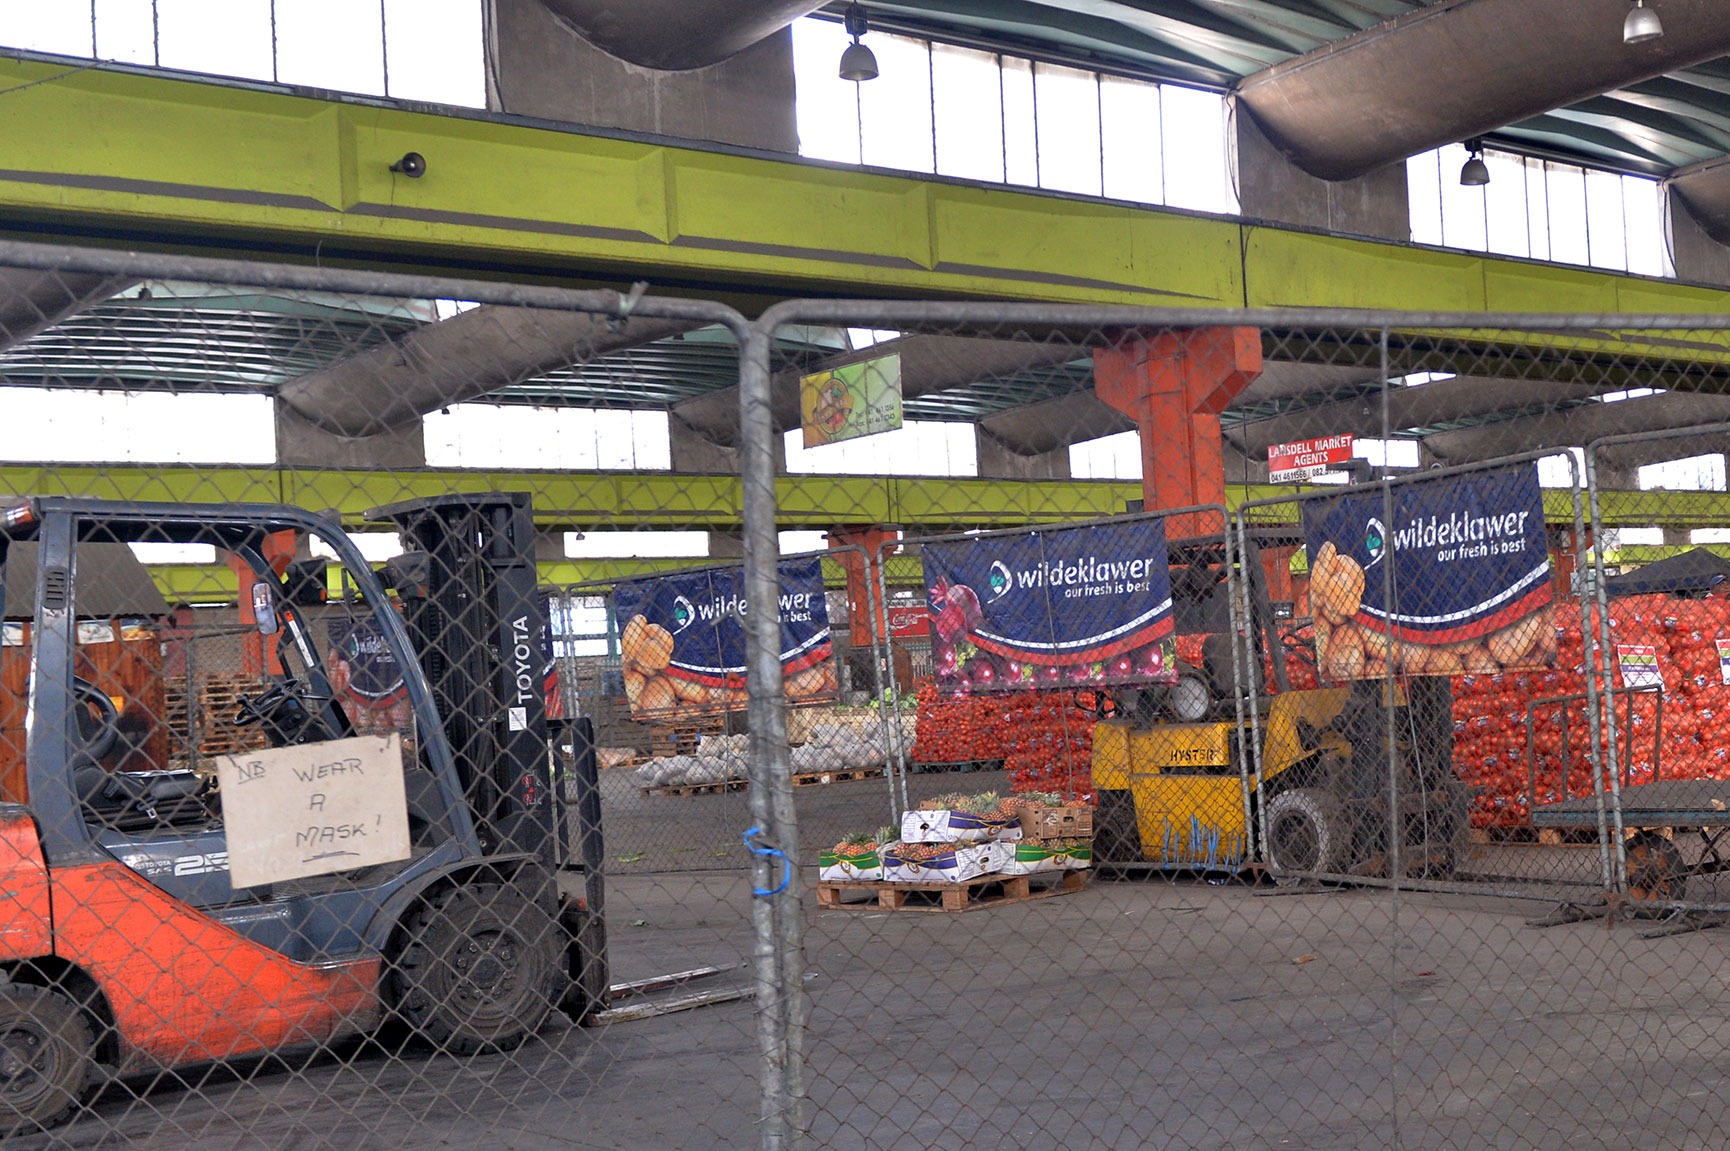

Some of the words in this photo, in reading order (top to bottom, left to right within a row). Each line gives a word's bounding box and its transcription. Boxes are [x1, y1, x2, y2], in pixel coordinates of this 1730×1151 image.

[1268, 441, 1312, 458] LANSDELL
[1314, 436, 1352, 451] MARKET
[1293, 451, 1329, 467] AGENTS
[1393, 511, 1529, 551] wildeklawer
[1437, 547, 1457, 562] our
[1459, 541, 1488, 559] fresh
[1490, 540, 1499, 555] is
[1501, 537, 1527, 553] best
[1017, 556, 1154, 589] wildeklawer
[1064, 587, 1083, 598] our
[1084, 582, 1113, 597] fresh
[1114, 581, 1124, 594] is
[1126, 579, 1151, 593] best
[698, 592, 813, 621] wildewer
[790, 610, 812, 622] best
[512, 615, 533, 704] TOYOTA
[1170, 749, 1215, 762] HYSTER
[237, 760, 266, 780] NB
[292, 757, 364, 782] WEAR
[309, 793, 327, 812] A
